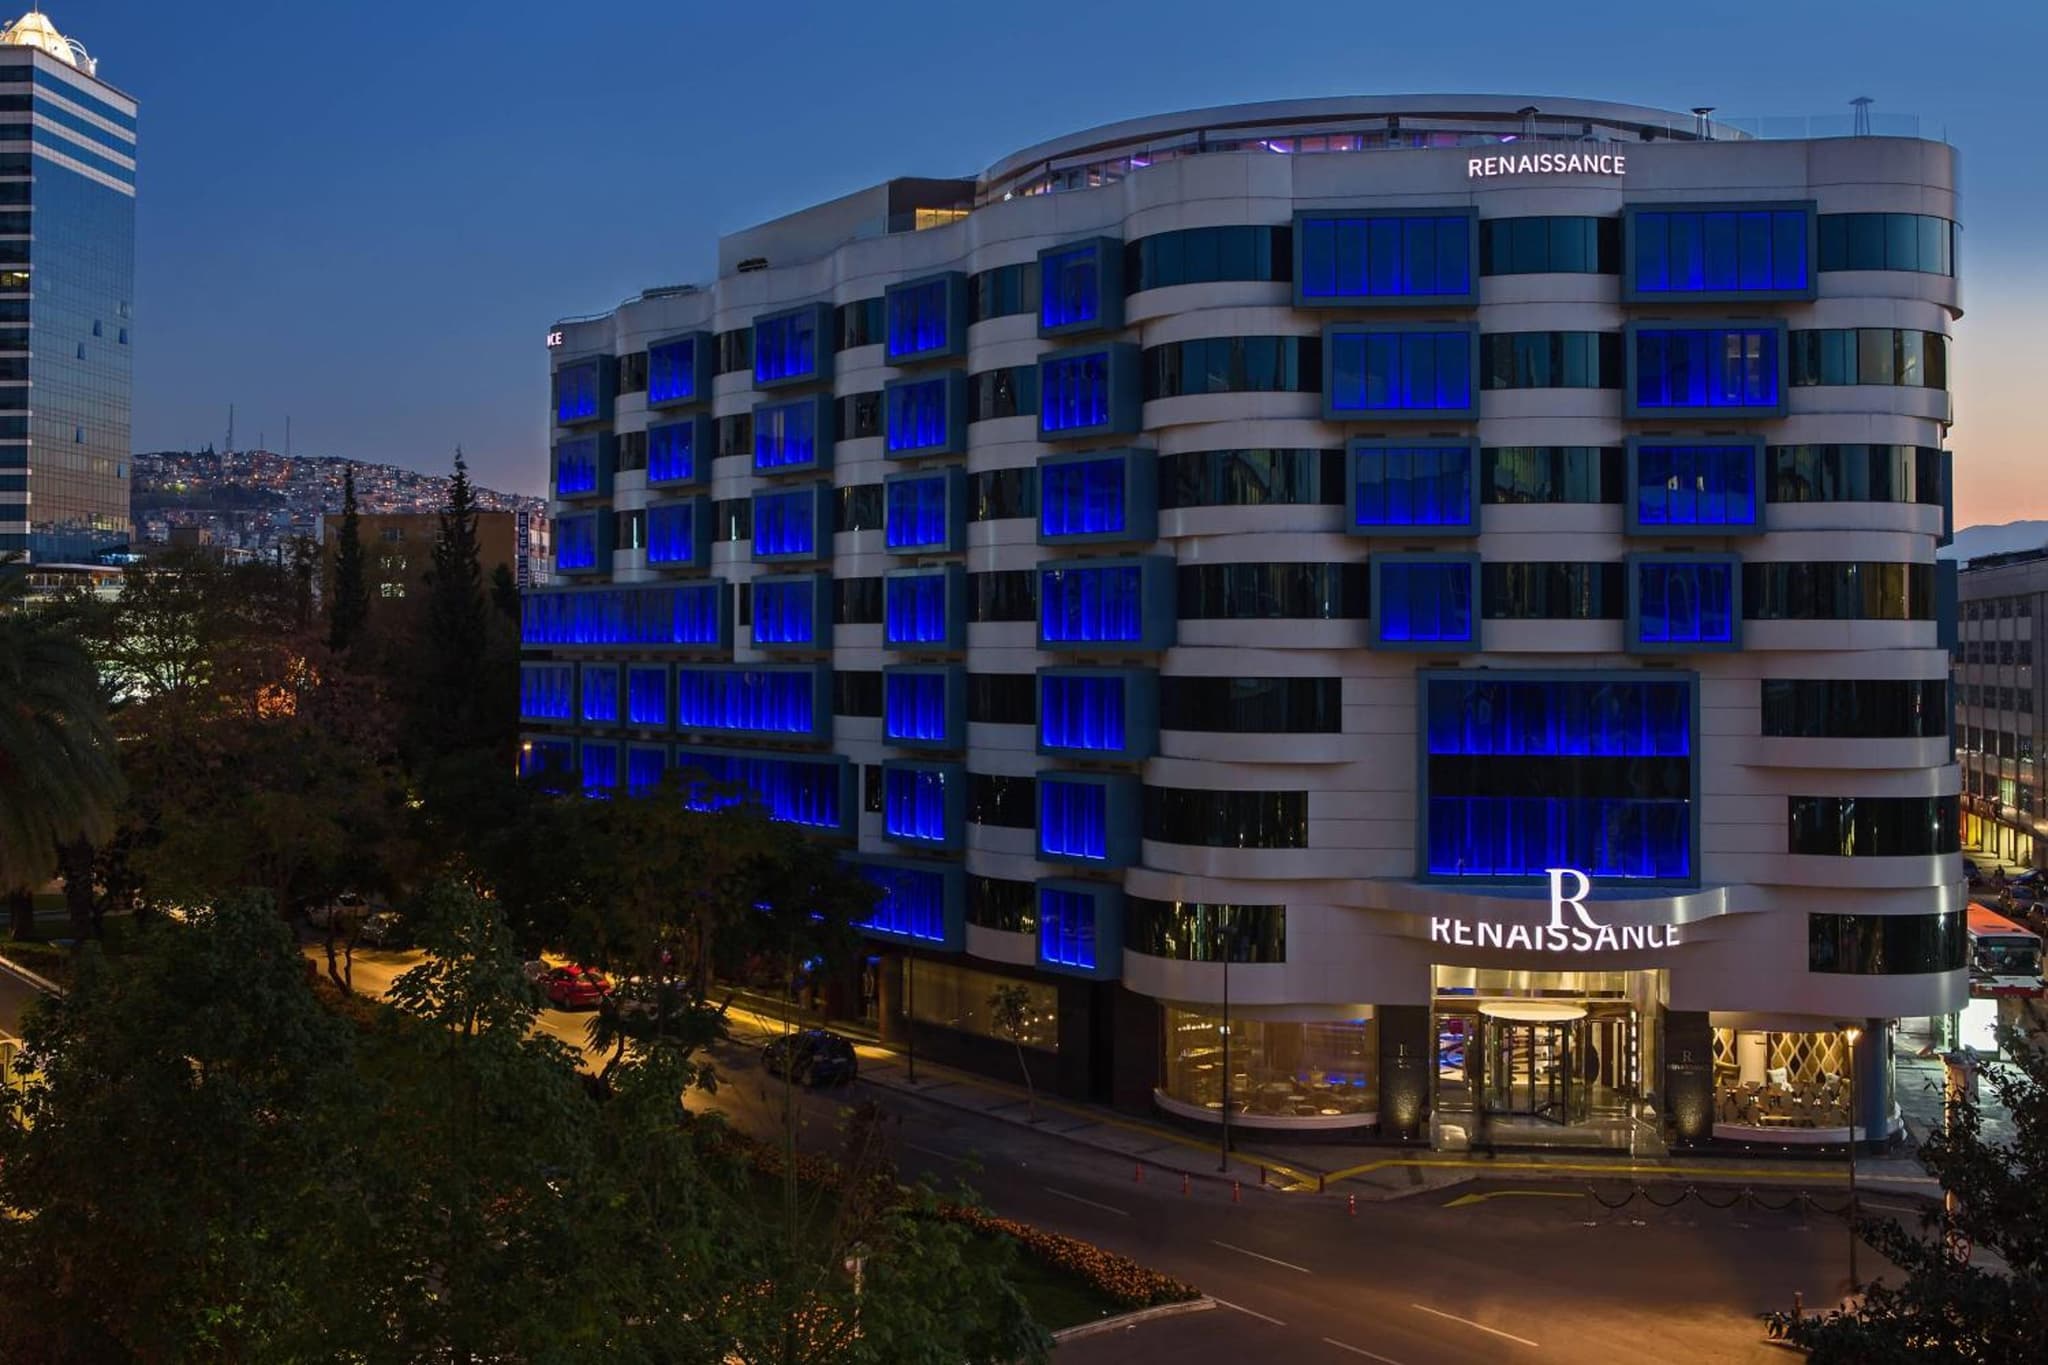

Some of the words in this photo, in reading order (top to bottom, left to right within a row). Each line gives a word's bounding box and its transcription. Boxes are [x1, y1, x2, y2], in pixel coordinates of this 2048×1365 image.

[1468, 154, 1626, 178] RENAISSANCE
[1544, 868, 1610, 930] R
[1431, 916, 1680, 951] RENAISSANCE
